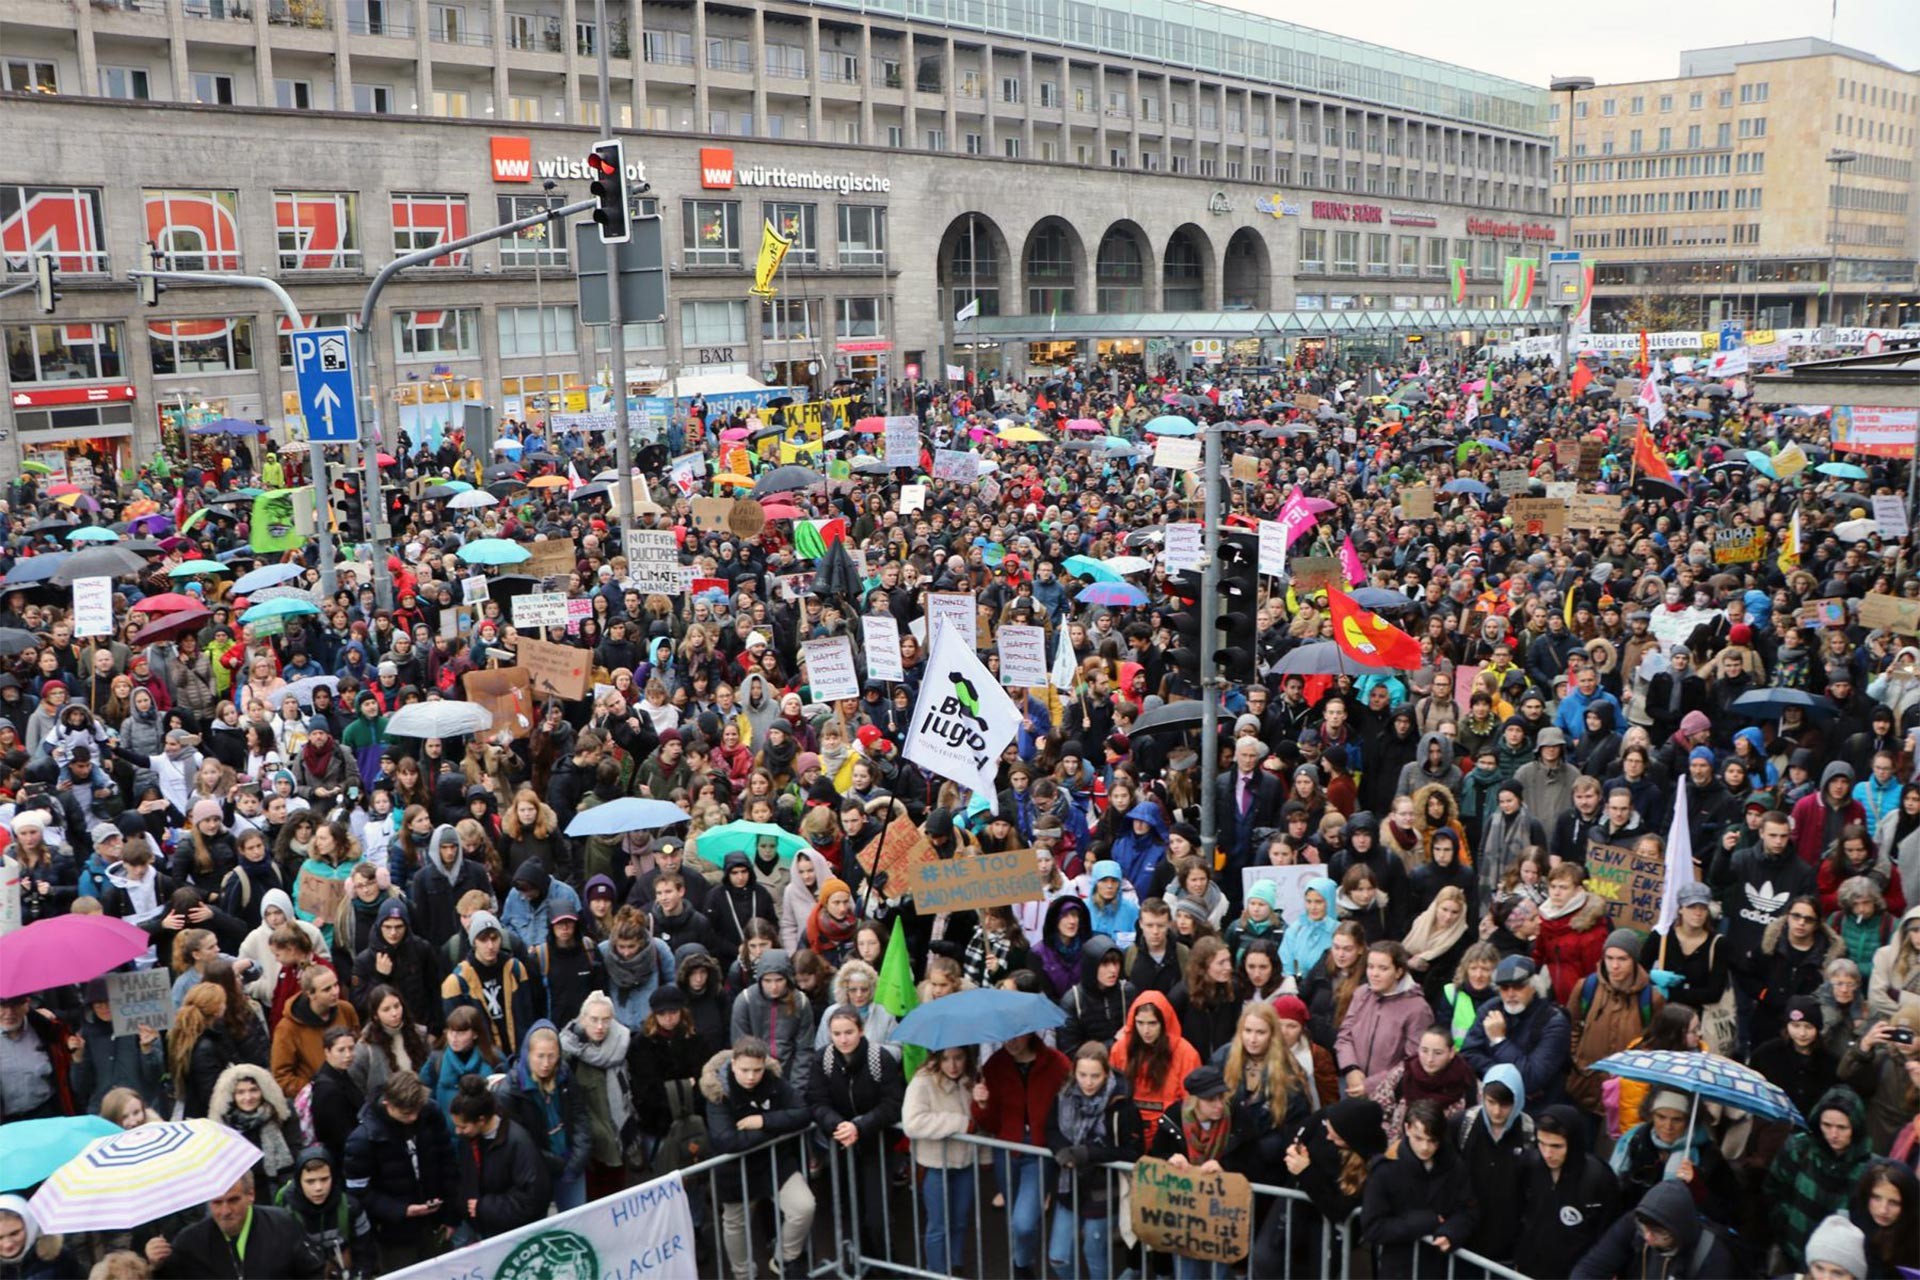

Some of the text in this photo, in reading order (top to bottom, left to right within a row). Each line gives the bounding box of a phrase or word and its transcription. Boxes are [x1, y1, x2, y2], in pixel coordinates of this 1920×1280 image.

[538, 156, 647, 181] wüstot
[739, 166, 891, 195] württembergische
[1312, 200, 1350, 220] BRUNO
[1592, 336, 1617, 350] lokal
[295, 337, 316, 374] P
[700, 347, 734, 364] BÄR
[629, 533, 676, 546] NOT EVEN
[631, 562, 671, 571] CAN FIX
[631, 570, 678, 583] CLIMATE
[632, 582, 678, 594] CHANGE
[974, 855, 1018, 873] TOO
[917, 888, 949, 909] SAID
[1632, 907, 1655, 923] IHR
[118, 972, 162, 992] MAKE
[124, 989, 167, 1001] PLANET
[125, 1013, 169, 1032] AGAIN
[1199, 1176, 1226, 1197] ist
[609, 1180, 682, 1228] HUMAN
[1168, 1191, 1197, 1210] wie
[1213, 1222, 1239, 1239] ist
[512, 1243, 541, 1269] FOR
